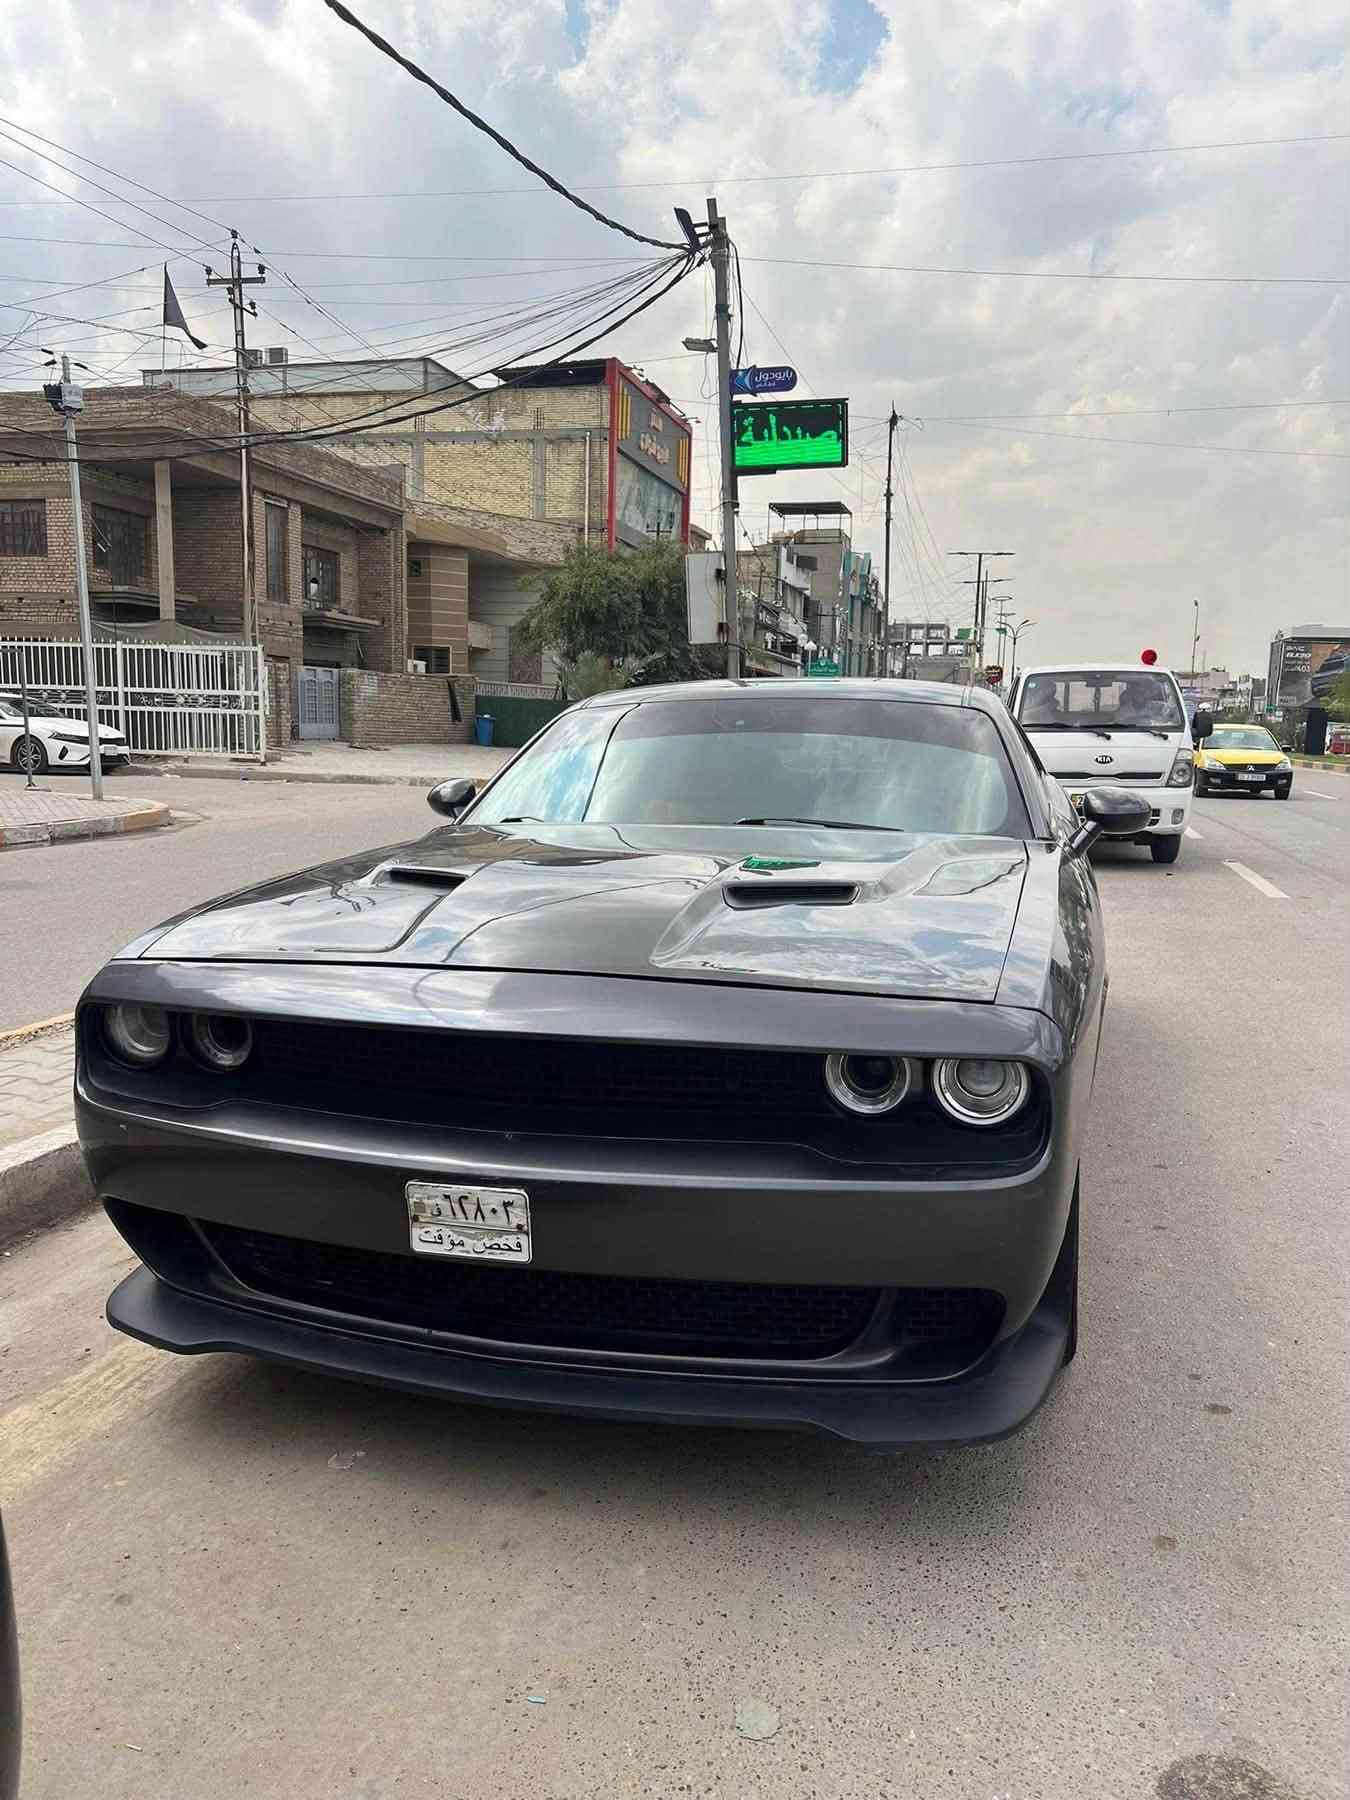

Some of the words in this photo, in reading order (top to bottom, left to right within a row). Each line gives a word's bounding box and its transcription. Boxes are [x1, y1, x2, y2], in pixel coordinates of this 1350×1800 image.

[1096, 755, 1112, 763] KIA
[443, 1193, 513, 1225] ٦٢٨٠٣
[473, 1236, 522, 1253] فحص
